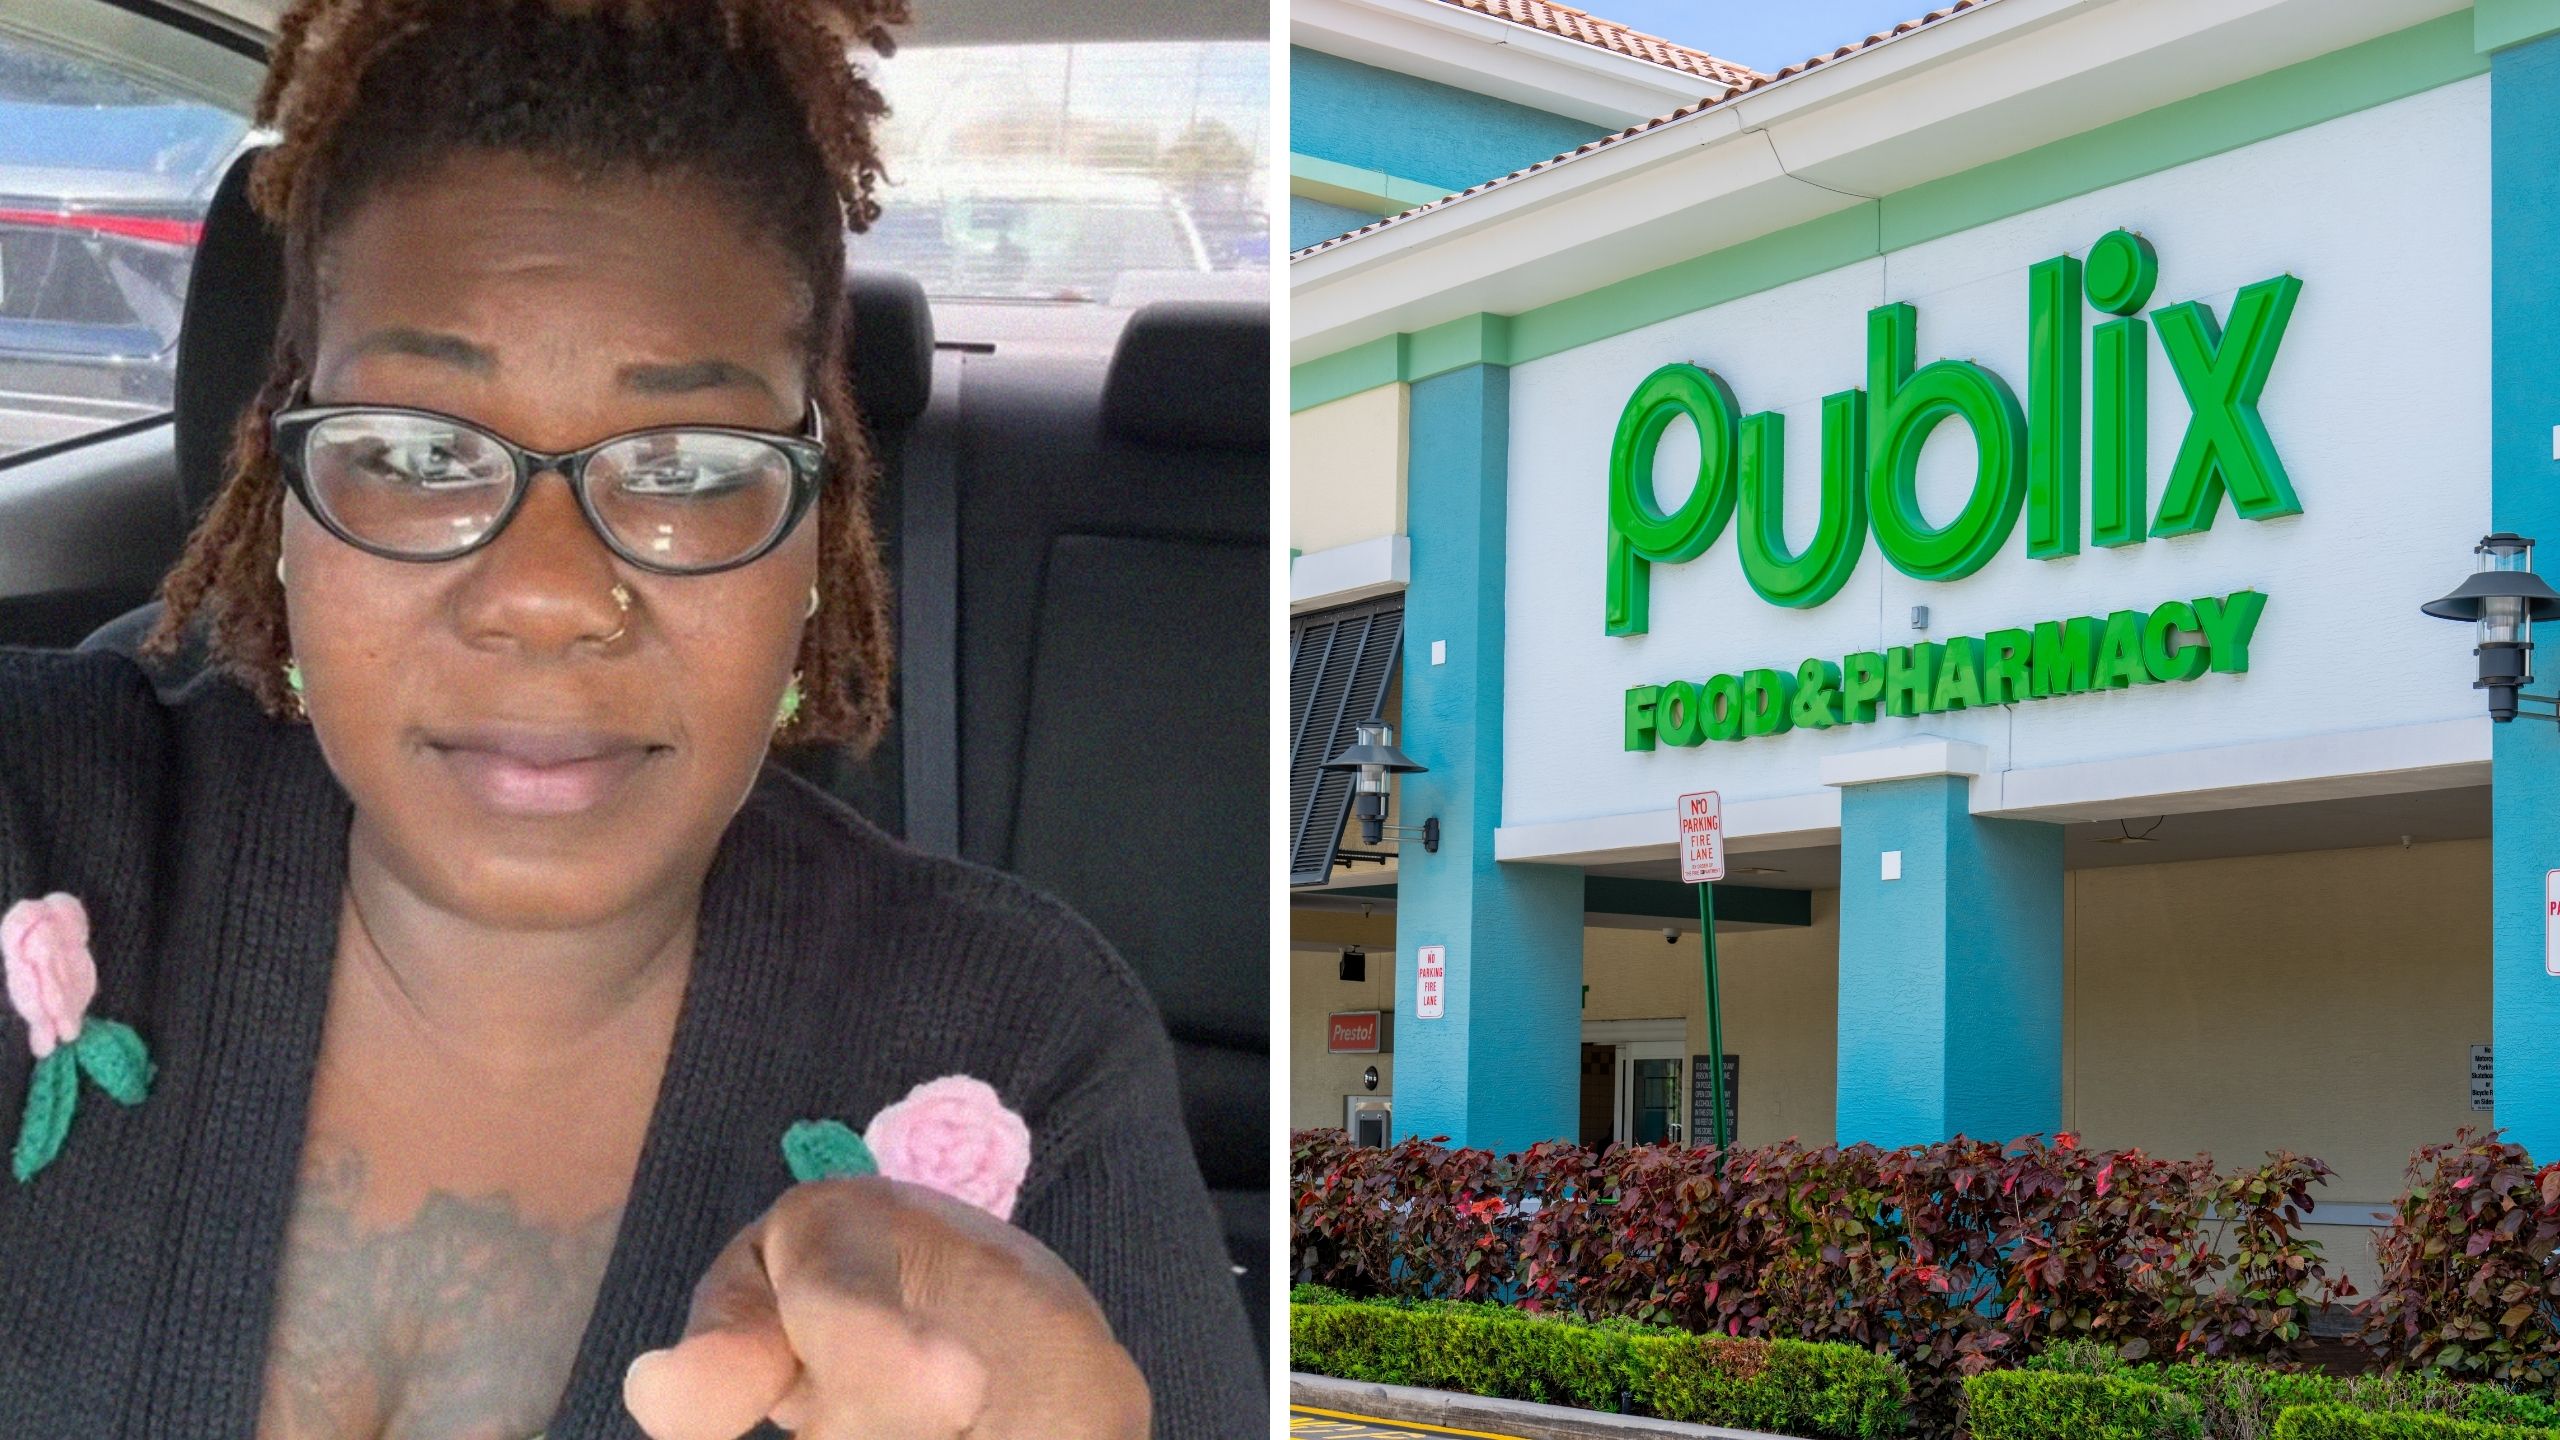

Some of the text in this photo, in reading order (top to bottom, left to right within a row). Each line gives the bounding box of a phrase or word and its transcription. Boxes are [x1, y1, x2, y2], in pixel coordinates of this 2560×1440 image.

[1691, 799, 1707, 815] NO
[1682, 815, 1718, 833] PARKING
[1691, 834, 1711, 847] FIRE
[1690, 848, 1713, 861] LANE
[1428, 954, 1435, 963] NO
[1420, 968, 1442, 977] PARKING
[1425, 981, 1437, 992] FIRE
[1424, 996, 1437, 1005] LANE
[1333, 1023, 1373, 1041] Presto!
